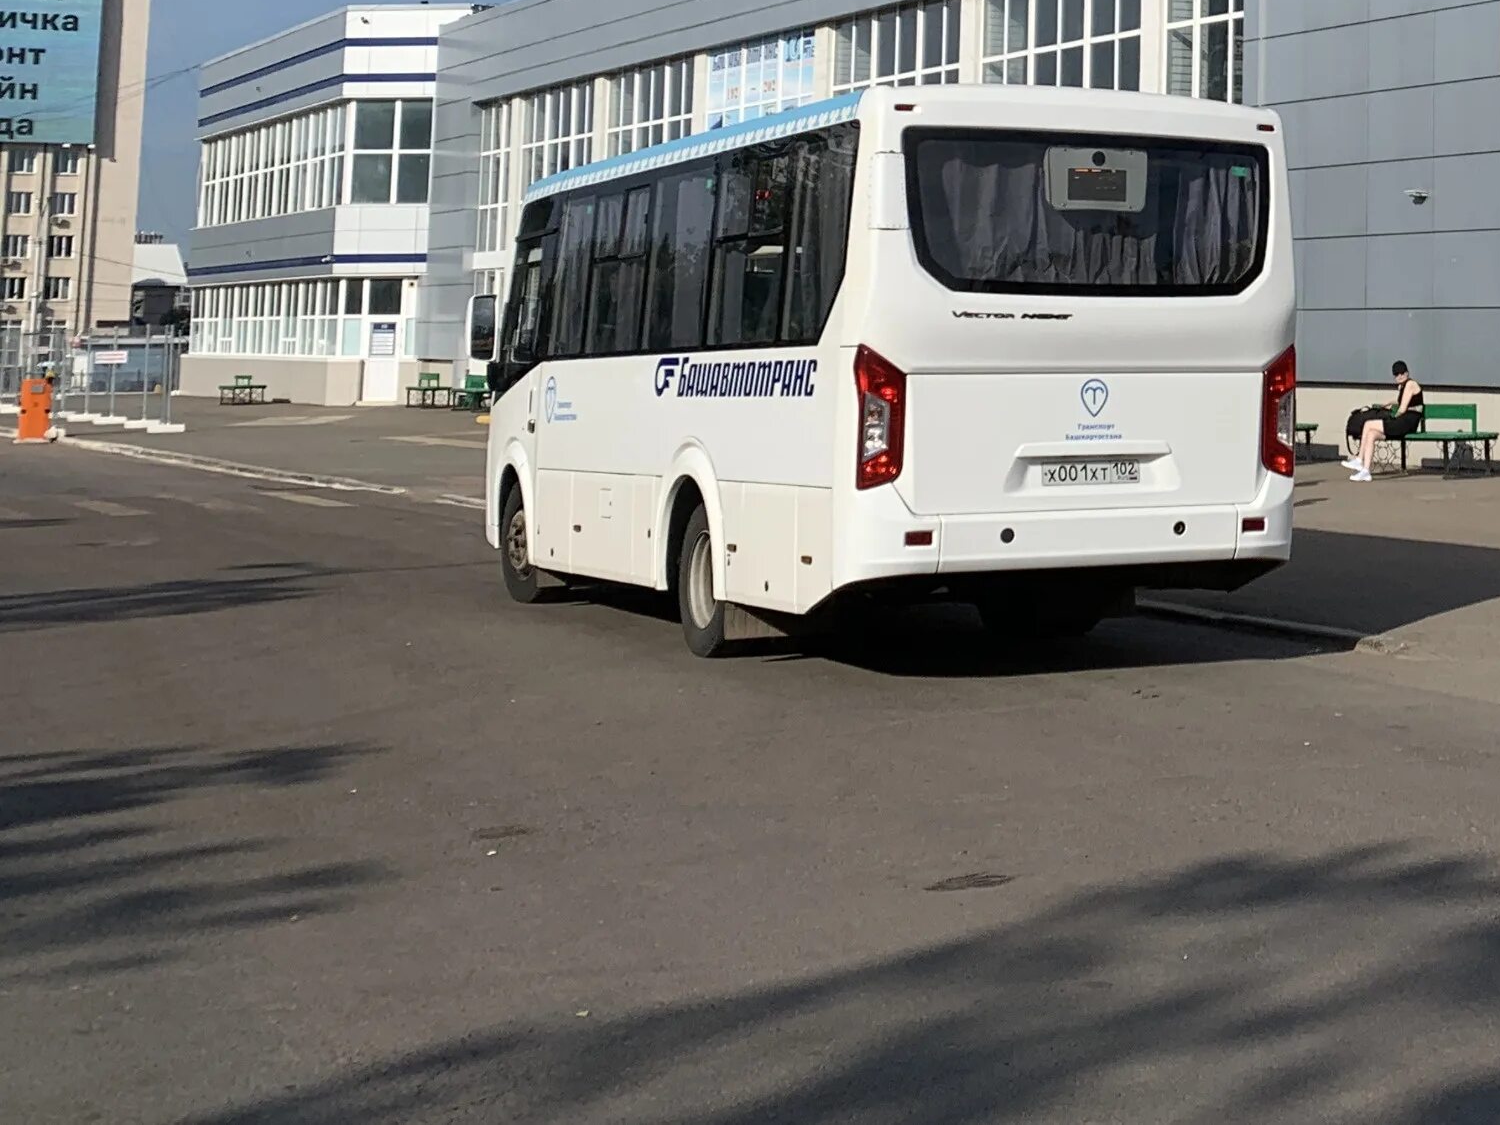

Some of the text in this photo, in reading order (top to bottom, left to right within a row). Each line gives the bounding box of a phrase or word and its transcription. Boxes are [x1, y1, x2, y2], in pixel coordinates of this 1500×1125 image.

[0, 47, 46, 65] нт
[1077, 423, 1116, 431] Транспорт
[1112, 461, 1135, 476] 102
